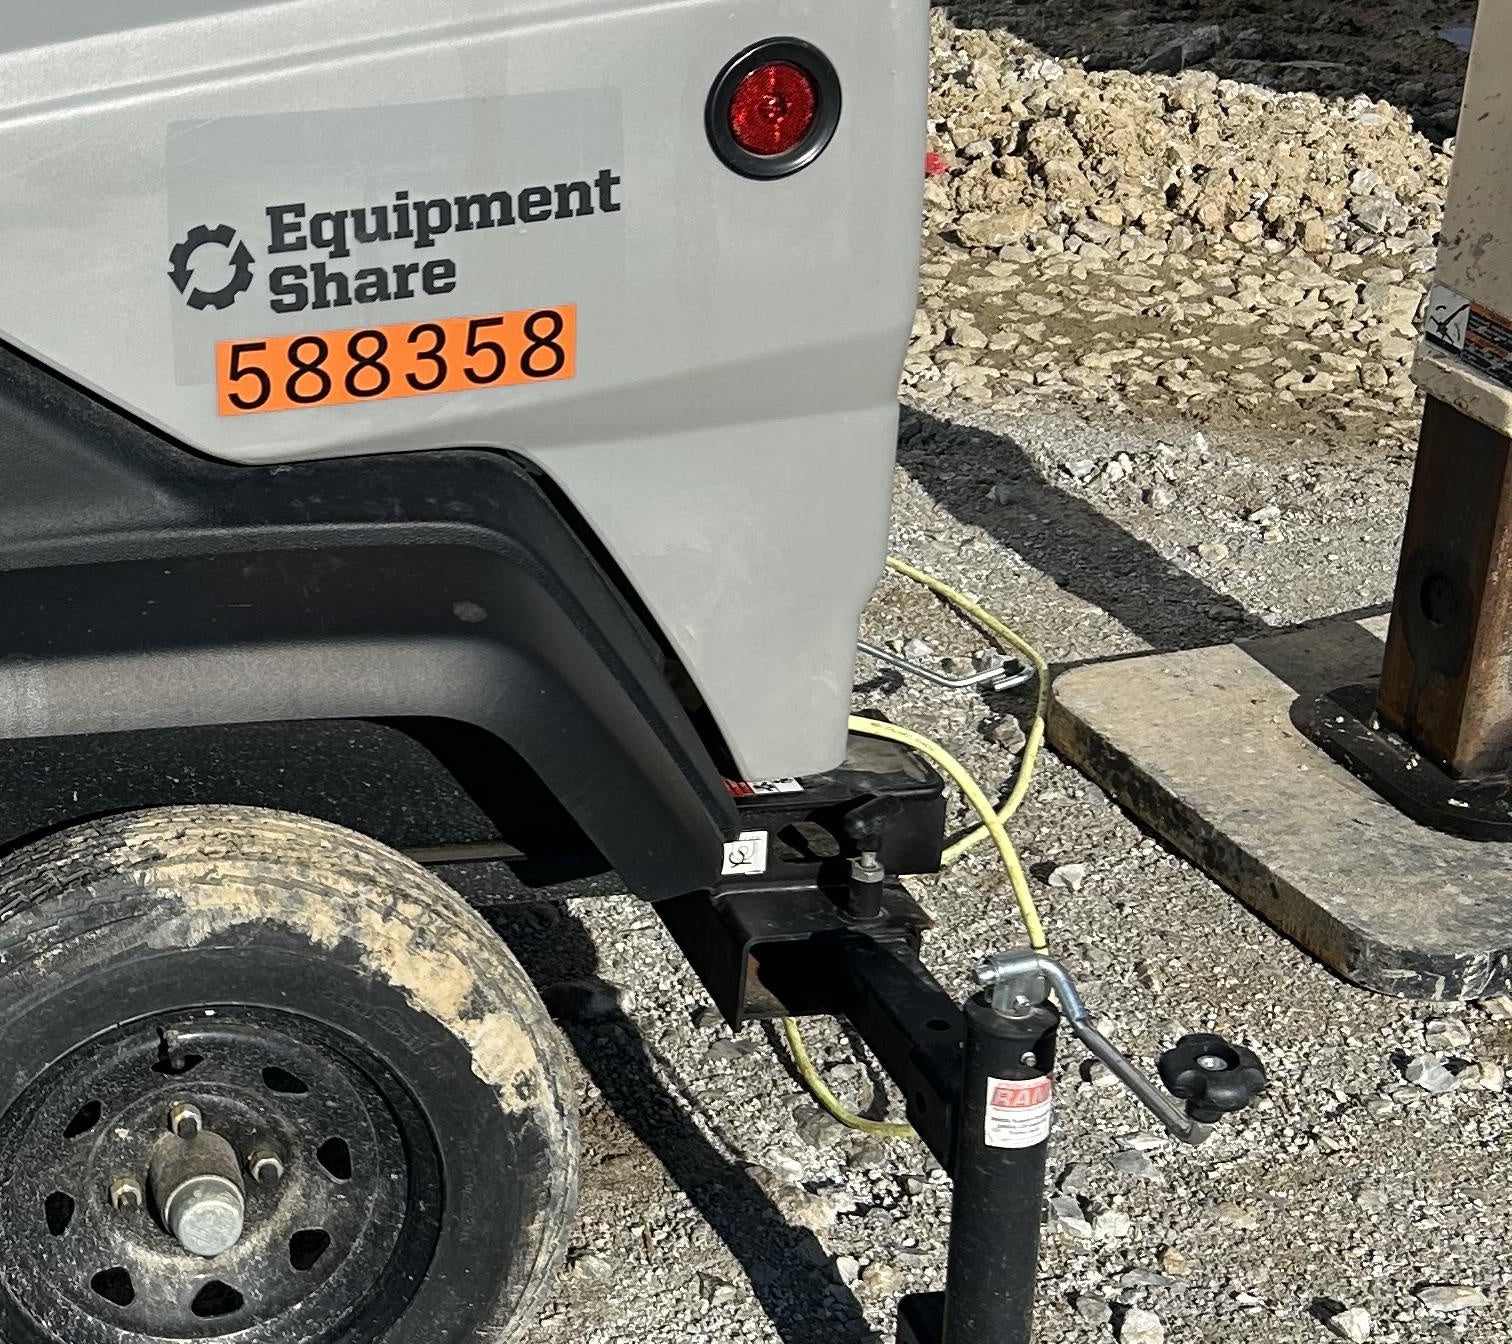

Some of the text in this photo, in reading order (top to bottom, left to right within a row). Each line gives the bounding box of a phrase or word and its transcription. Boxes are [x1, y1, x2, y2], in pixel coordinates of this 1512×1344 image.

[266, 168, 622, 259] Equipment
[268, 257, 457, 314] Share
[226, 309, 567, 410] 588358
